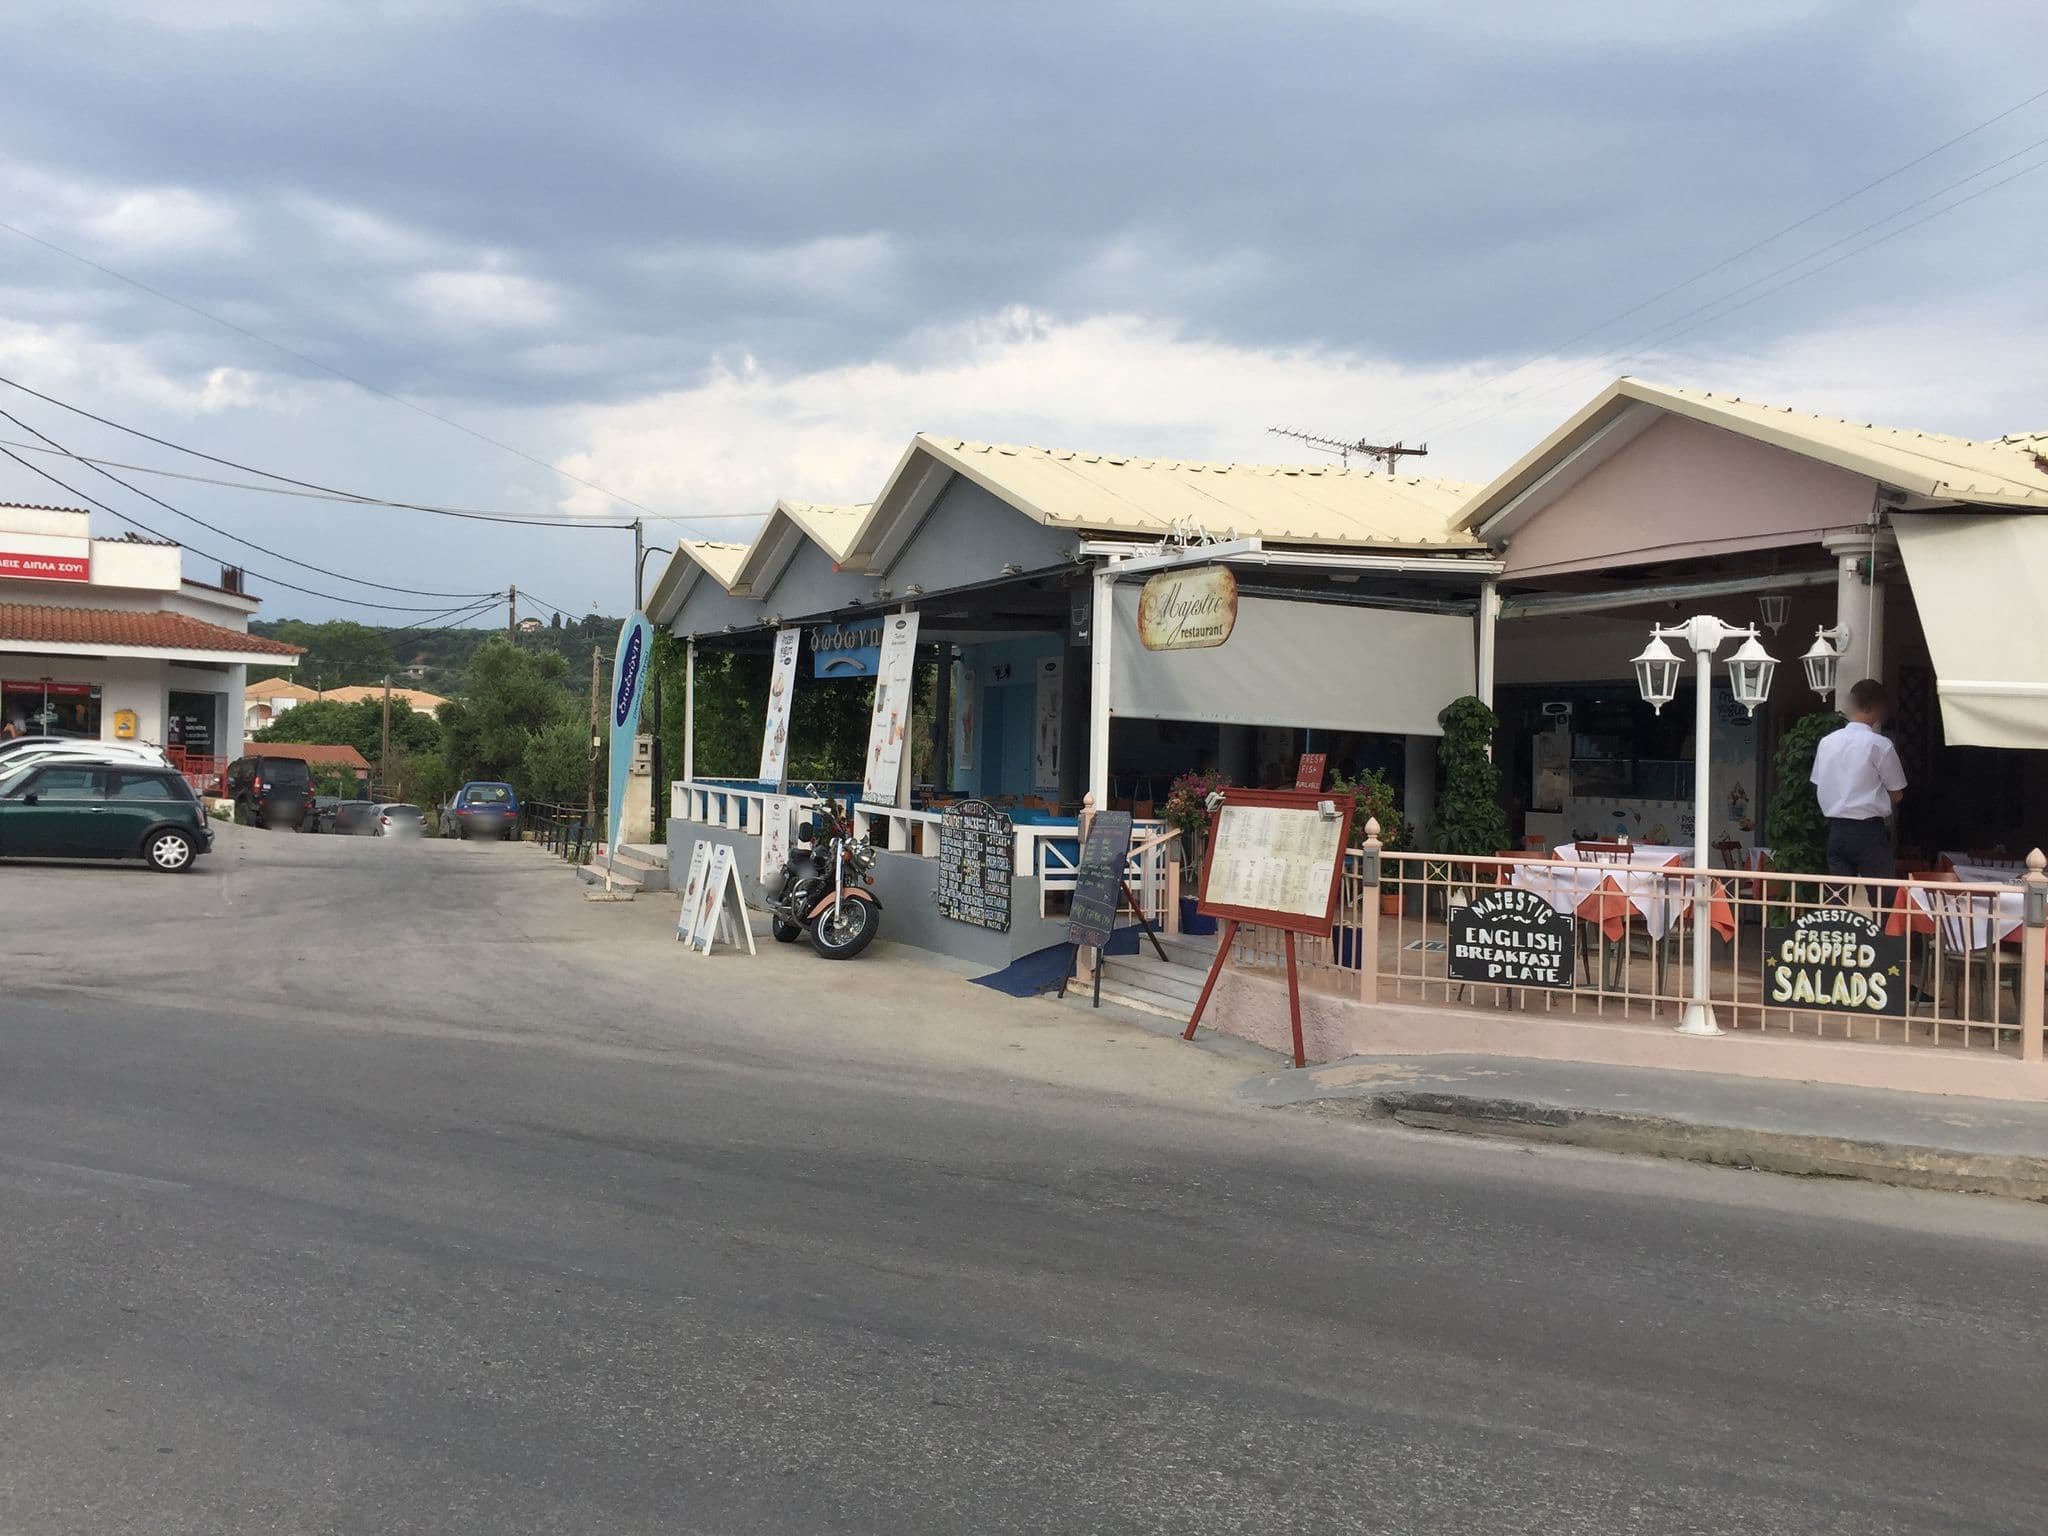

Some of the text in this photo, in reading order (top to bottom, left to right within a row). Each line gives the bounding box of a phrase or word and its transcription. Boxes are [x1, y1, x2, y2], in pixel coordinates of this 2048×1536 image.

[23, 561, 55, 570] ΔΙΠΛΑ
[58, 563, 83, 573] ΣΟΥ!
[1159, 582, 1223, 646] Majestic
[1181, 624, 1223, 639] restaurant
[1471, 891, 1553, 925] MAJESTIC
[1797, 910, 1880, 937] MAJESTIC'S
[1466, 927, 1562, 952] ENGLISH
[1795, 929, 1856, 944] FRESH
[1456, 944, 1562, 967] BREAKFAST
[1781, 940, 1876, 968] CHOPPED
[1488, 963, 1559, 982] PLATE
[1772, 965, 1888, 1010] SALADS
